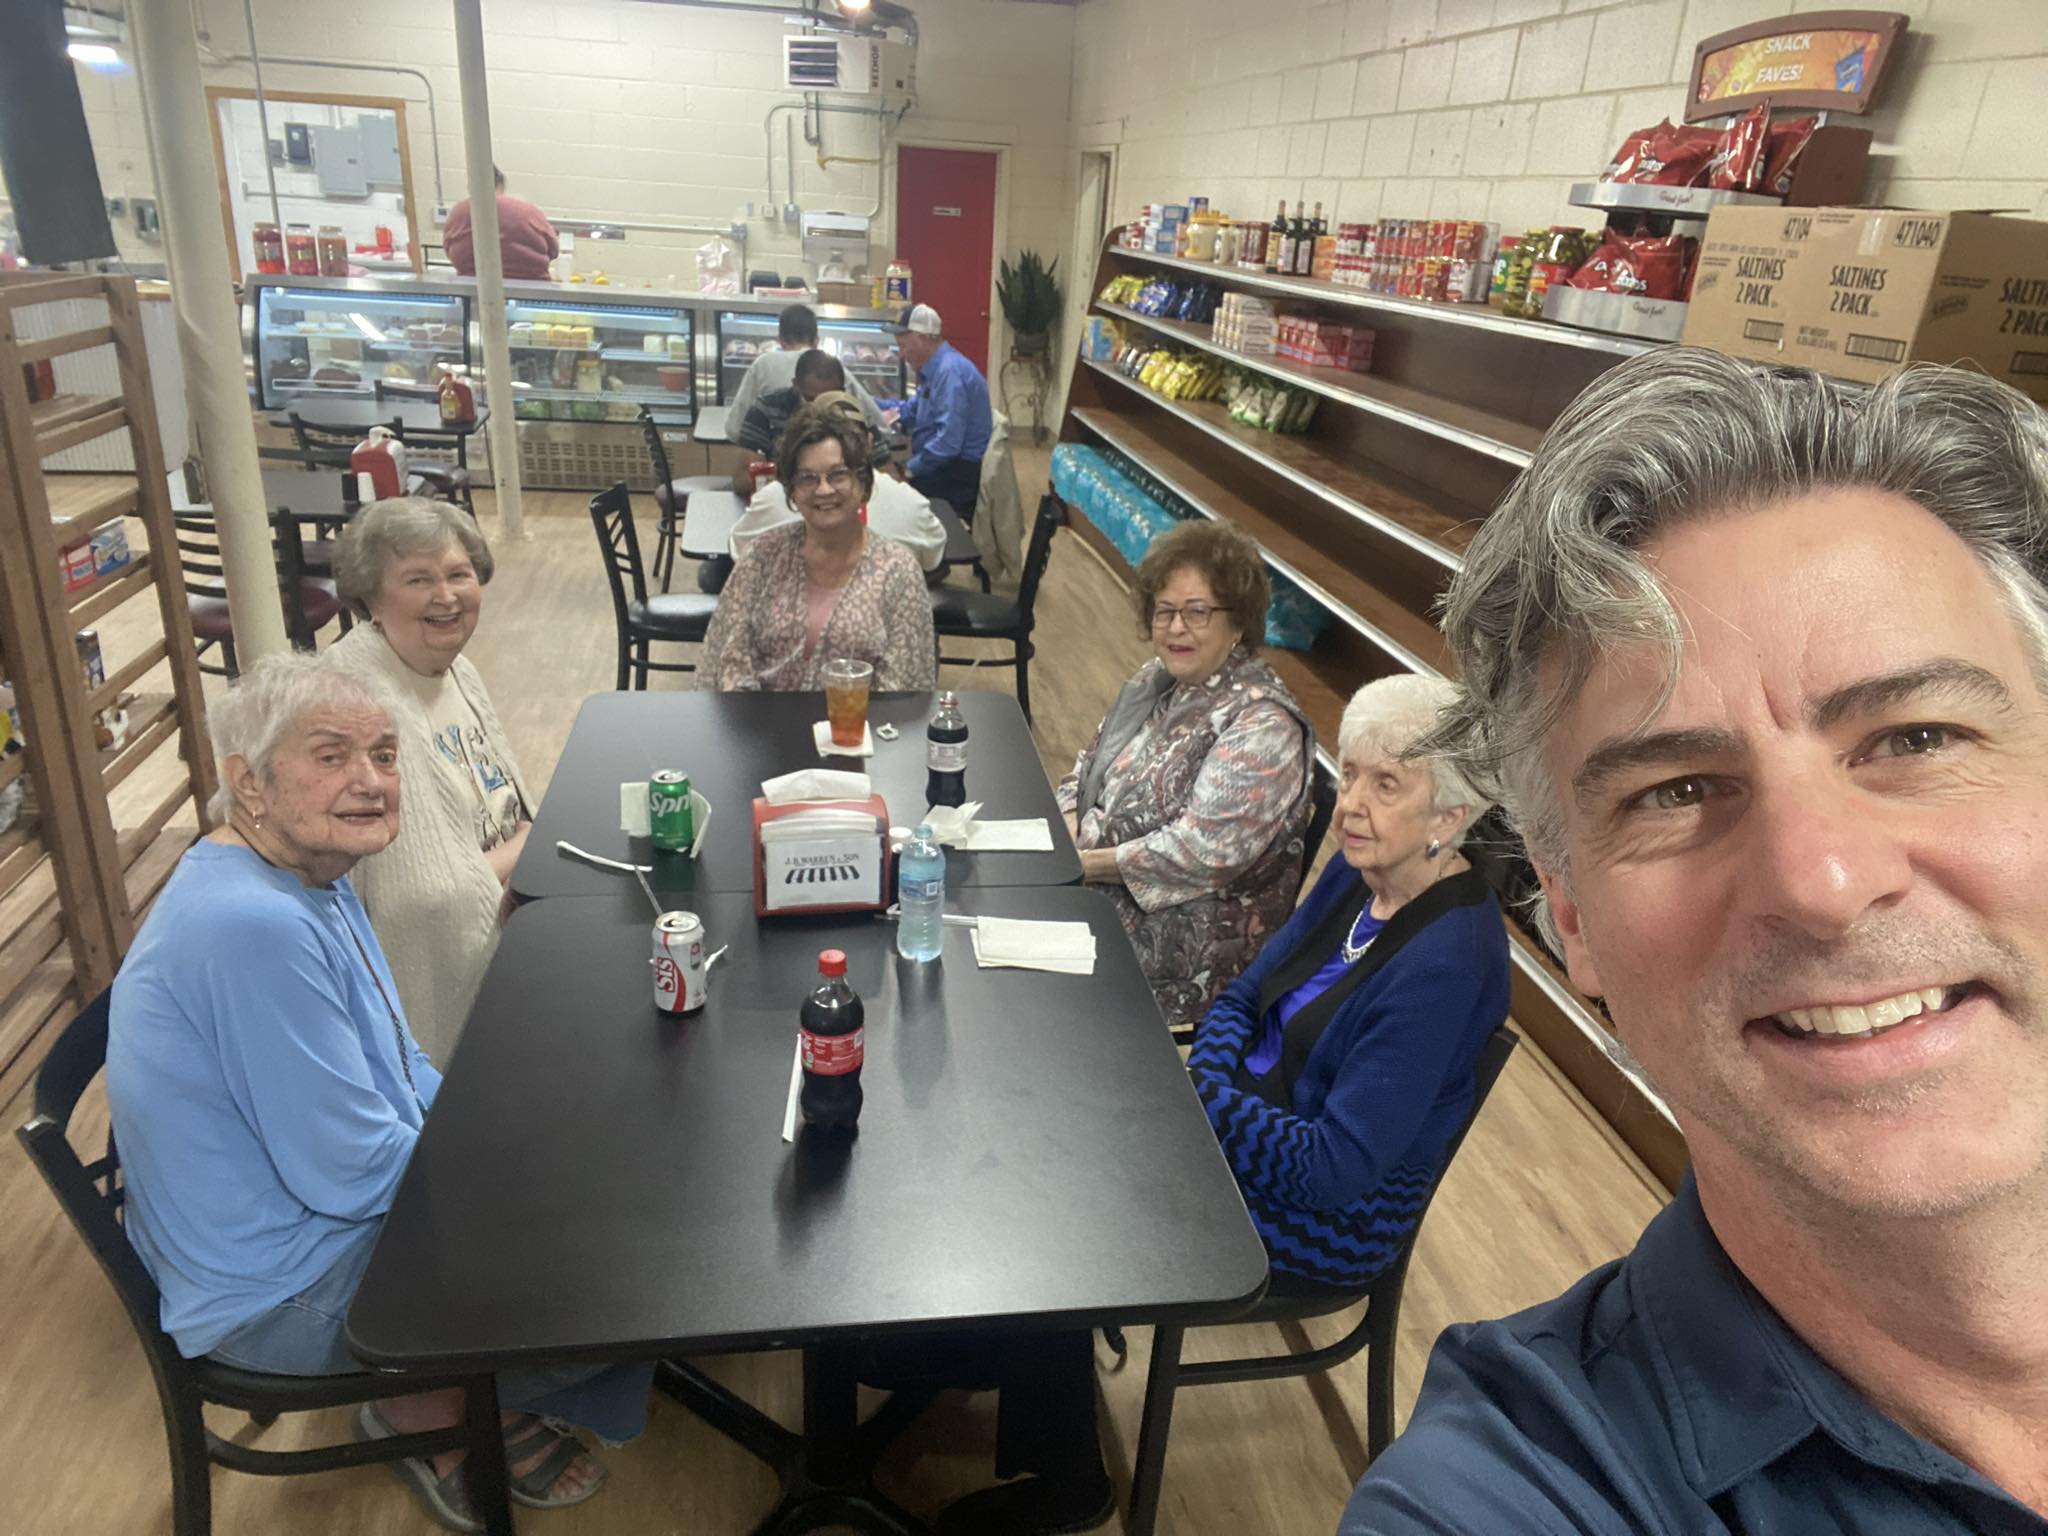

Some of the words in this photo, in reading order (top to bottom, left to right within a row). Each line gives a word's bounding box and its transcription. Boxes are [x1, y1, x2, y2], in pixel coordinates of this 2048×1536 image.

[1765, 33, 1814, 54] SNACK
[1756, 64, 1804, 83] FAVES!
[1896, 220, 1942, 247] 471040
[1736, 256, 1786, 281] SALTINES
[1829, 265, 1888, 291] SALTINES
[1735, 282, 1744, 303] 2
[1744, 283, 1772, 307] PACK
[1830, 291, 1841, 312] 2
[1839, 293, 1873, 316] PACK
[2000, 308, 2013, 333] 2
